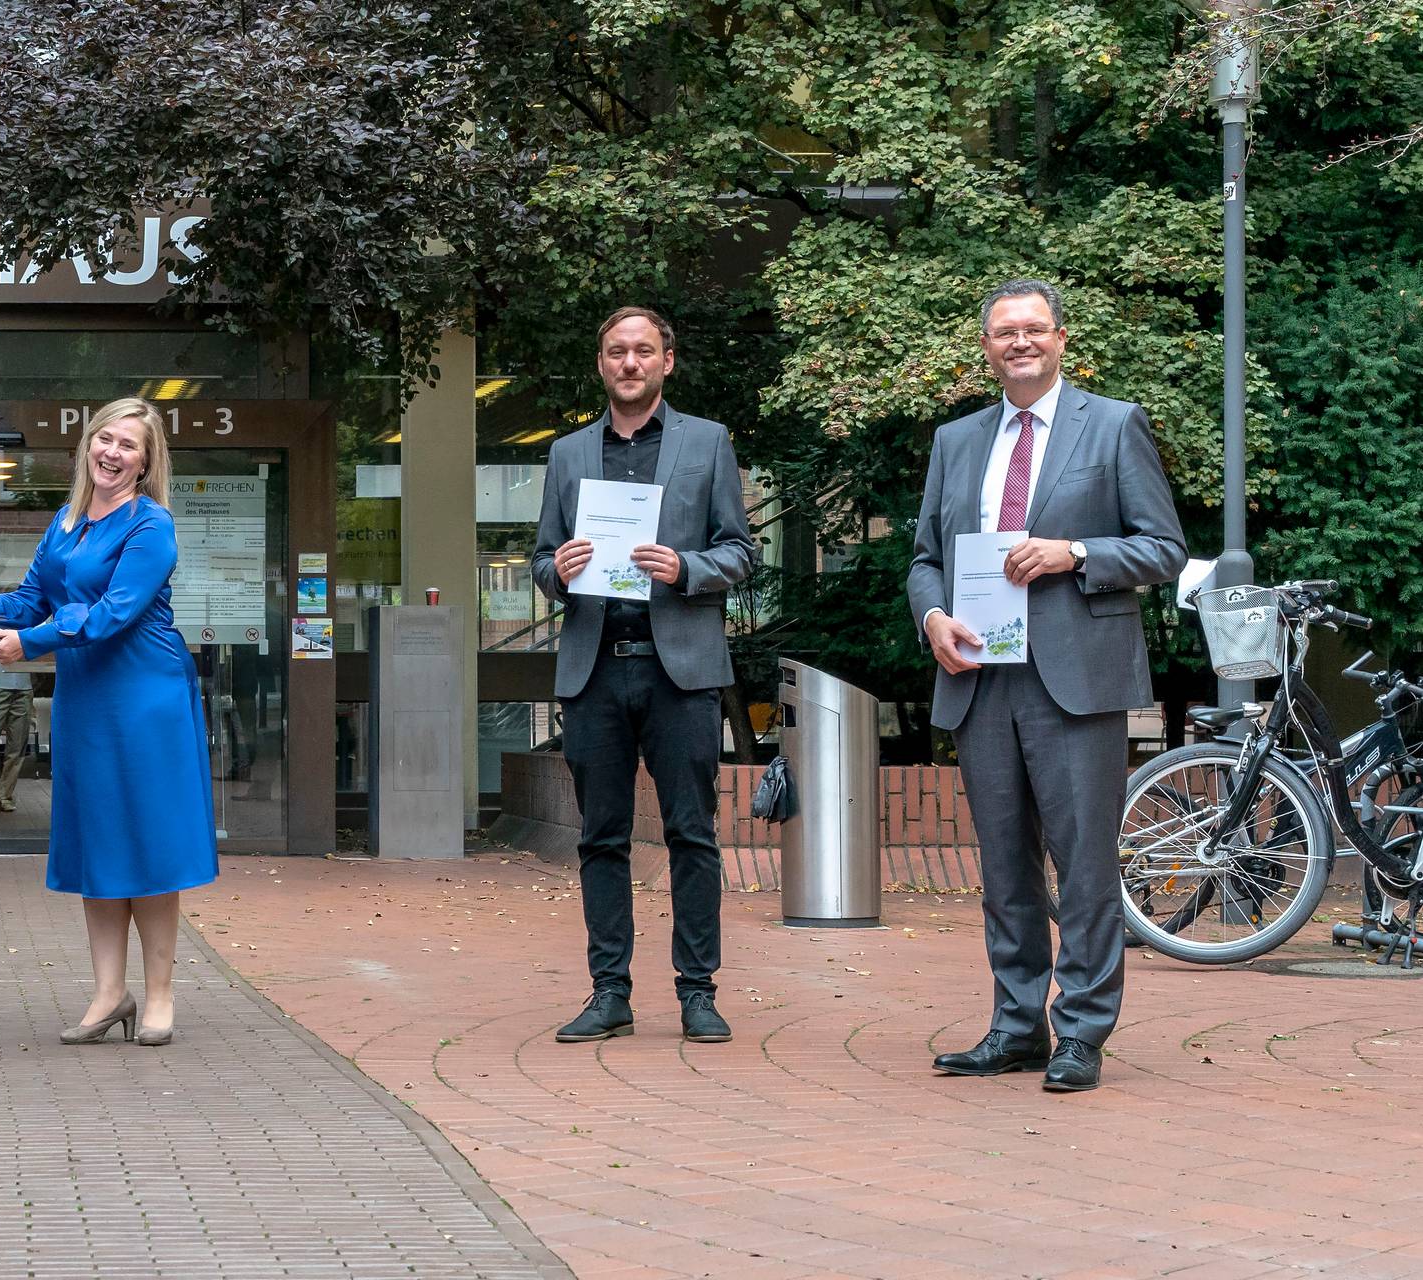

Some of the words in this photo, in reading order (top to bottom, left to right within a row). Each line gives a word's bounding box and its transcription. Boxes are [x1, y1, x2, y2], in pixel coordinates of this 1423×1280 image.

[60, 405, 90, 435] Pl
[166, 407, 179, 435] 1
[215, 407, 234, 436] 3
[169, 482, 195, 493] TADT
[206, 482, 255, 493] FRECHEN
[185, 500, 231, 508] Öffnungszeiten
[337, 526, 398, 541] rechen
